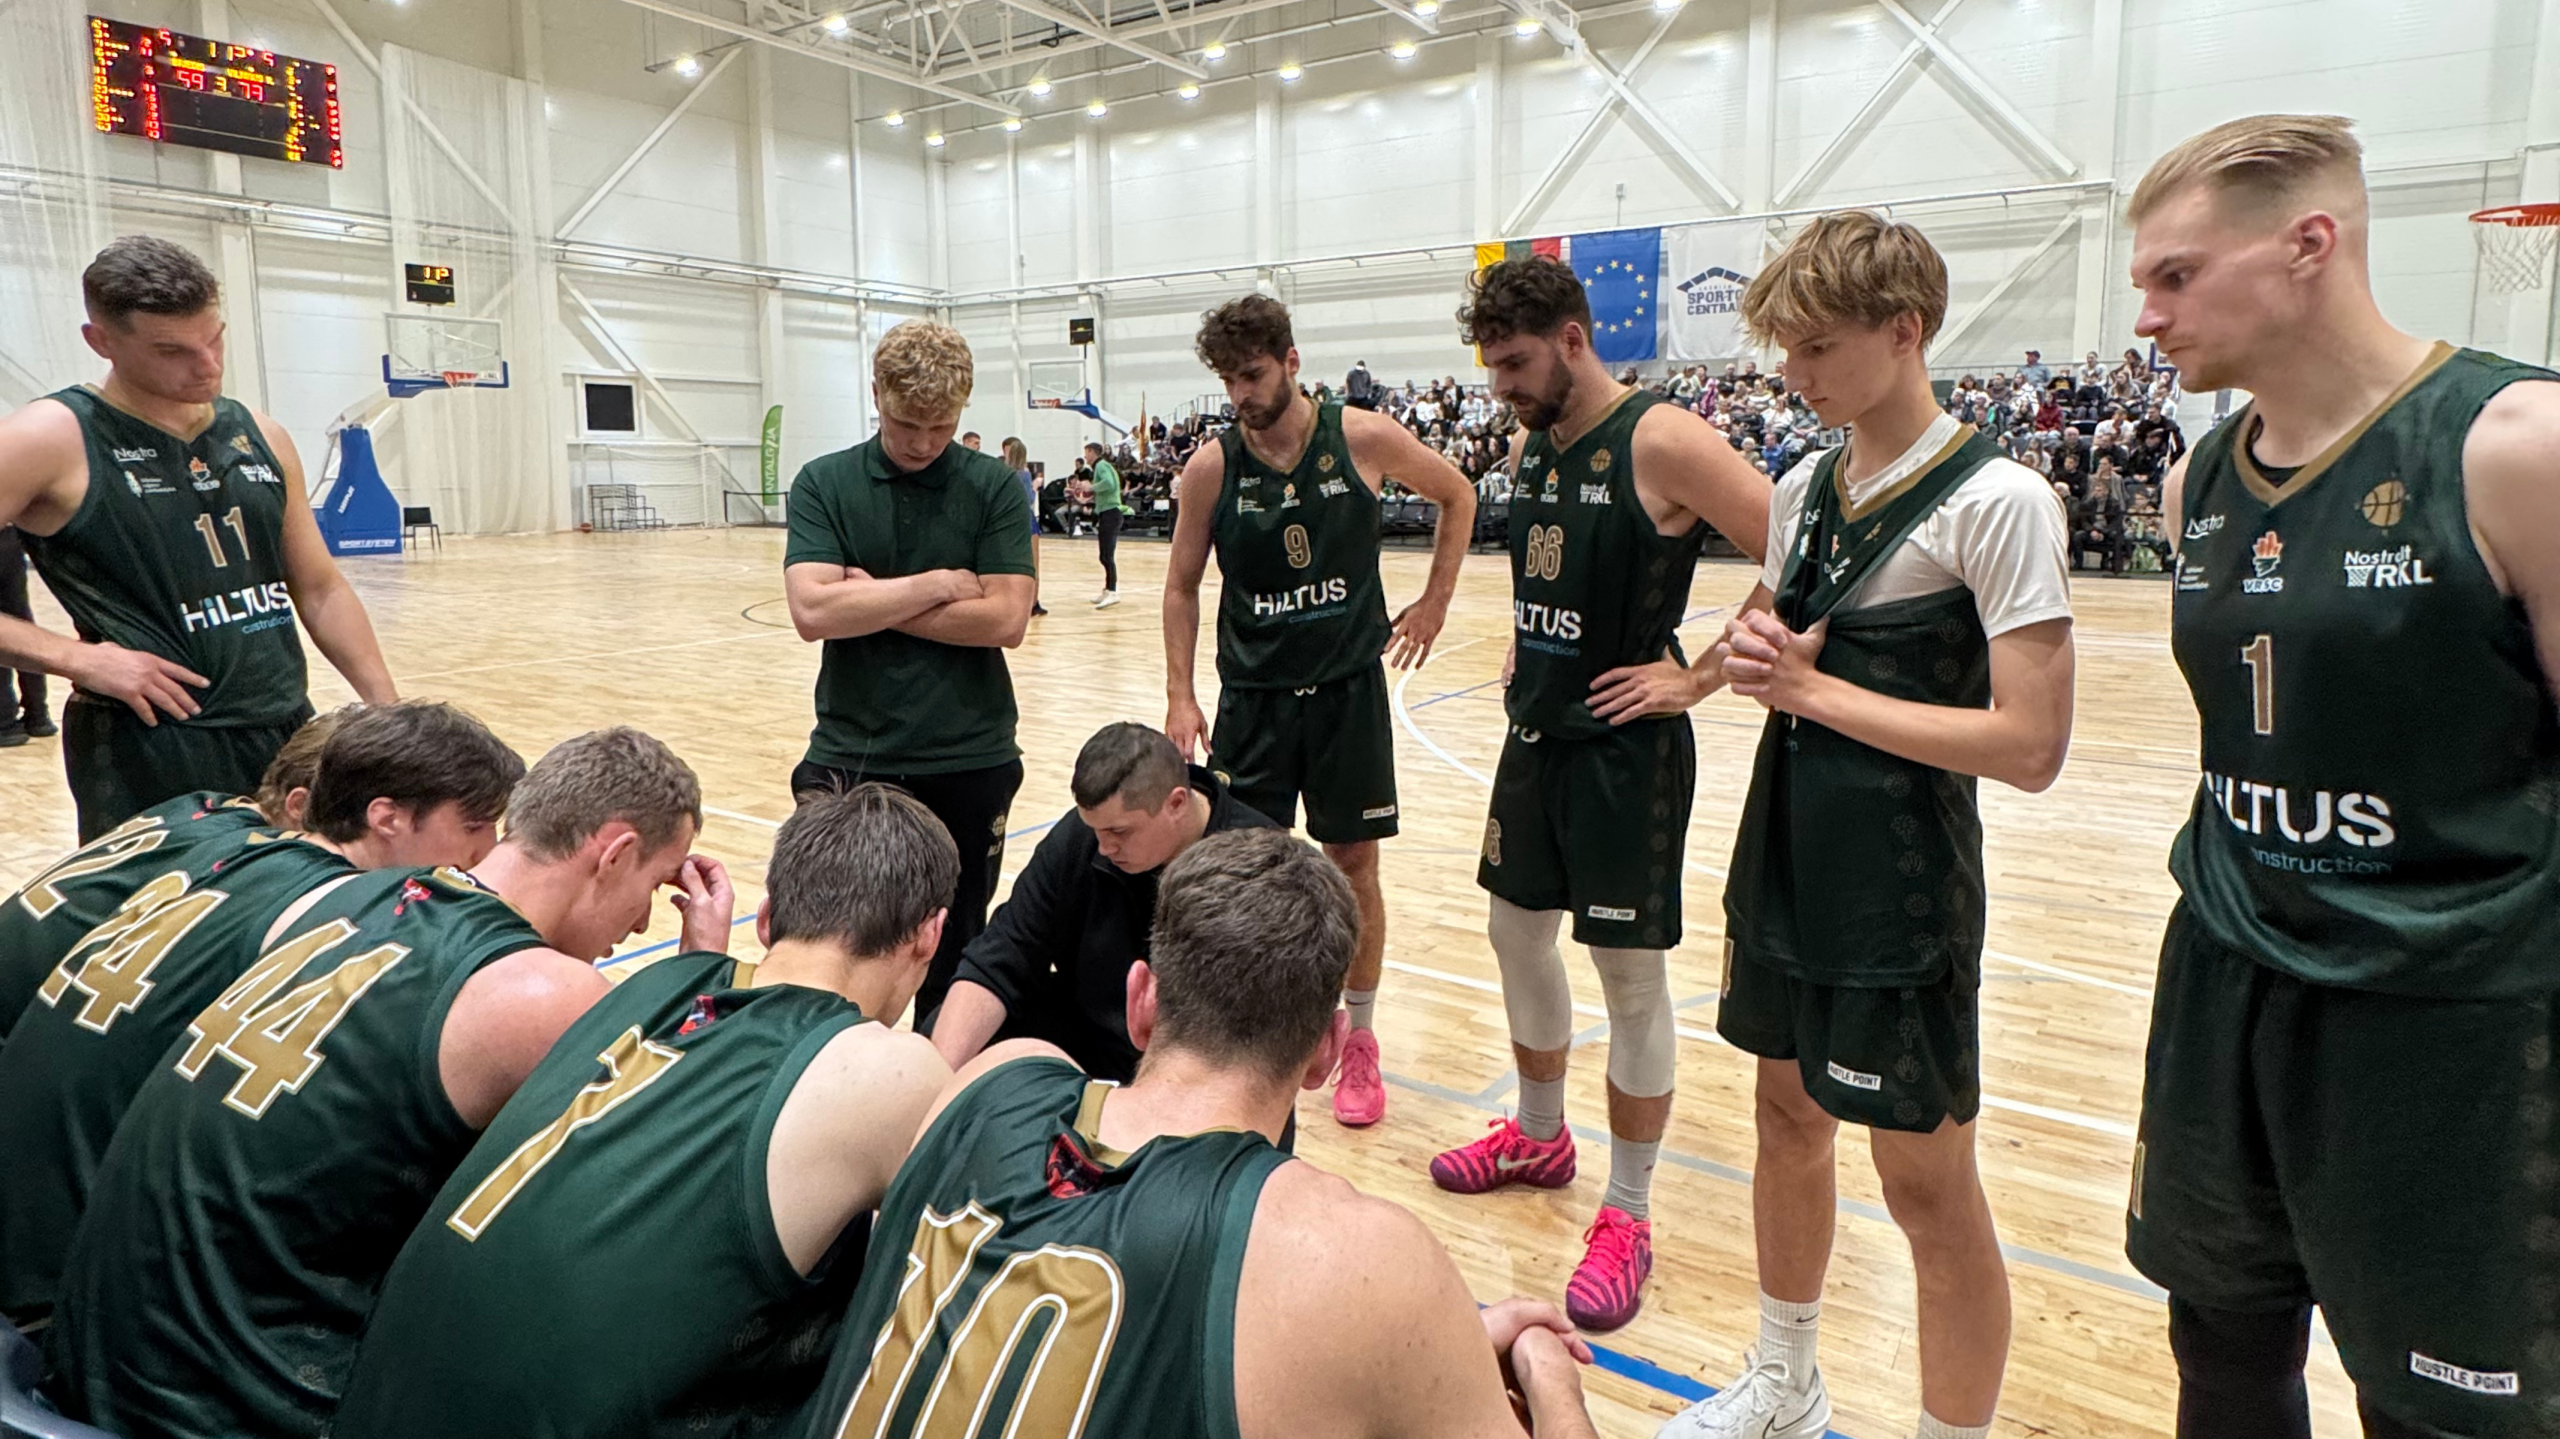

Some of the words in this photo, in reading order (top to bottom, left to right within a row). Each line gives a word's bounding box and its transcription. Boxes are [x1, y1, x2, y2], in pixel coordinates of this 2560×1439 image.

[177, 69, 204, 91] 59
[238, 81, 264, 102] 73
[1687, 290, 1743, 304] SPORTO
[1687, 303, 1737, 315] CENTRA
[193, 506, 250, 568] 11
[2186, 514, 2225, 534] Nstra
[1283, 524, 1312, 569] 9
[1525, 523, 1564, 582] 66
[2374, 559, 2433, 587] RKL
[1254, 577, 1347, 616] HILTUS
[2240, 633, 2273, 737] 1
[2252, 847, 2393, 875] nstruction
[38, 870, 230, 1035] 24
[173, 917, 413, 1120] 44
[1852, 1073, 1879, 1087] POINT
[832, 1200, 1126, 1439] 10
[2415, 1357, 2469, 1386] HUSTLE
[2473, 1374, 2514, 1390] POINT
